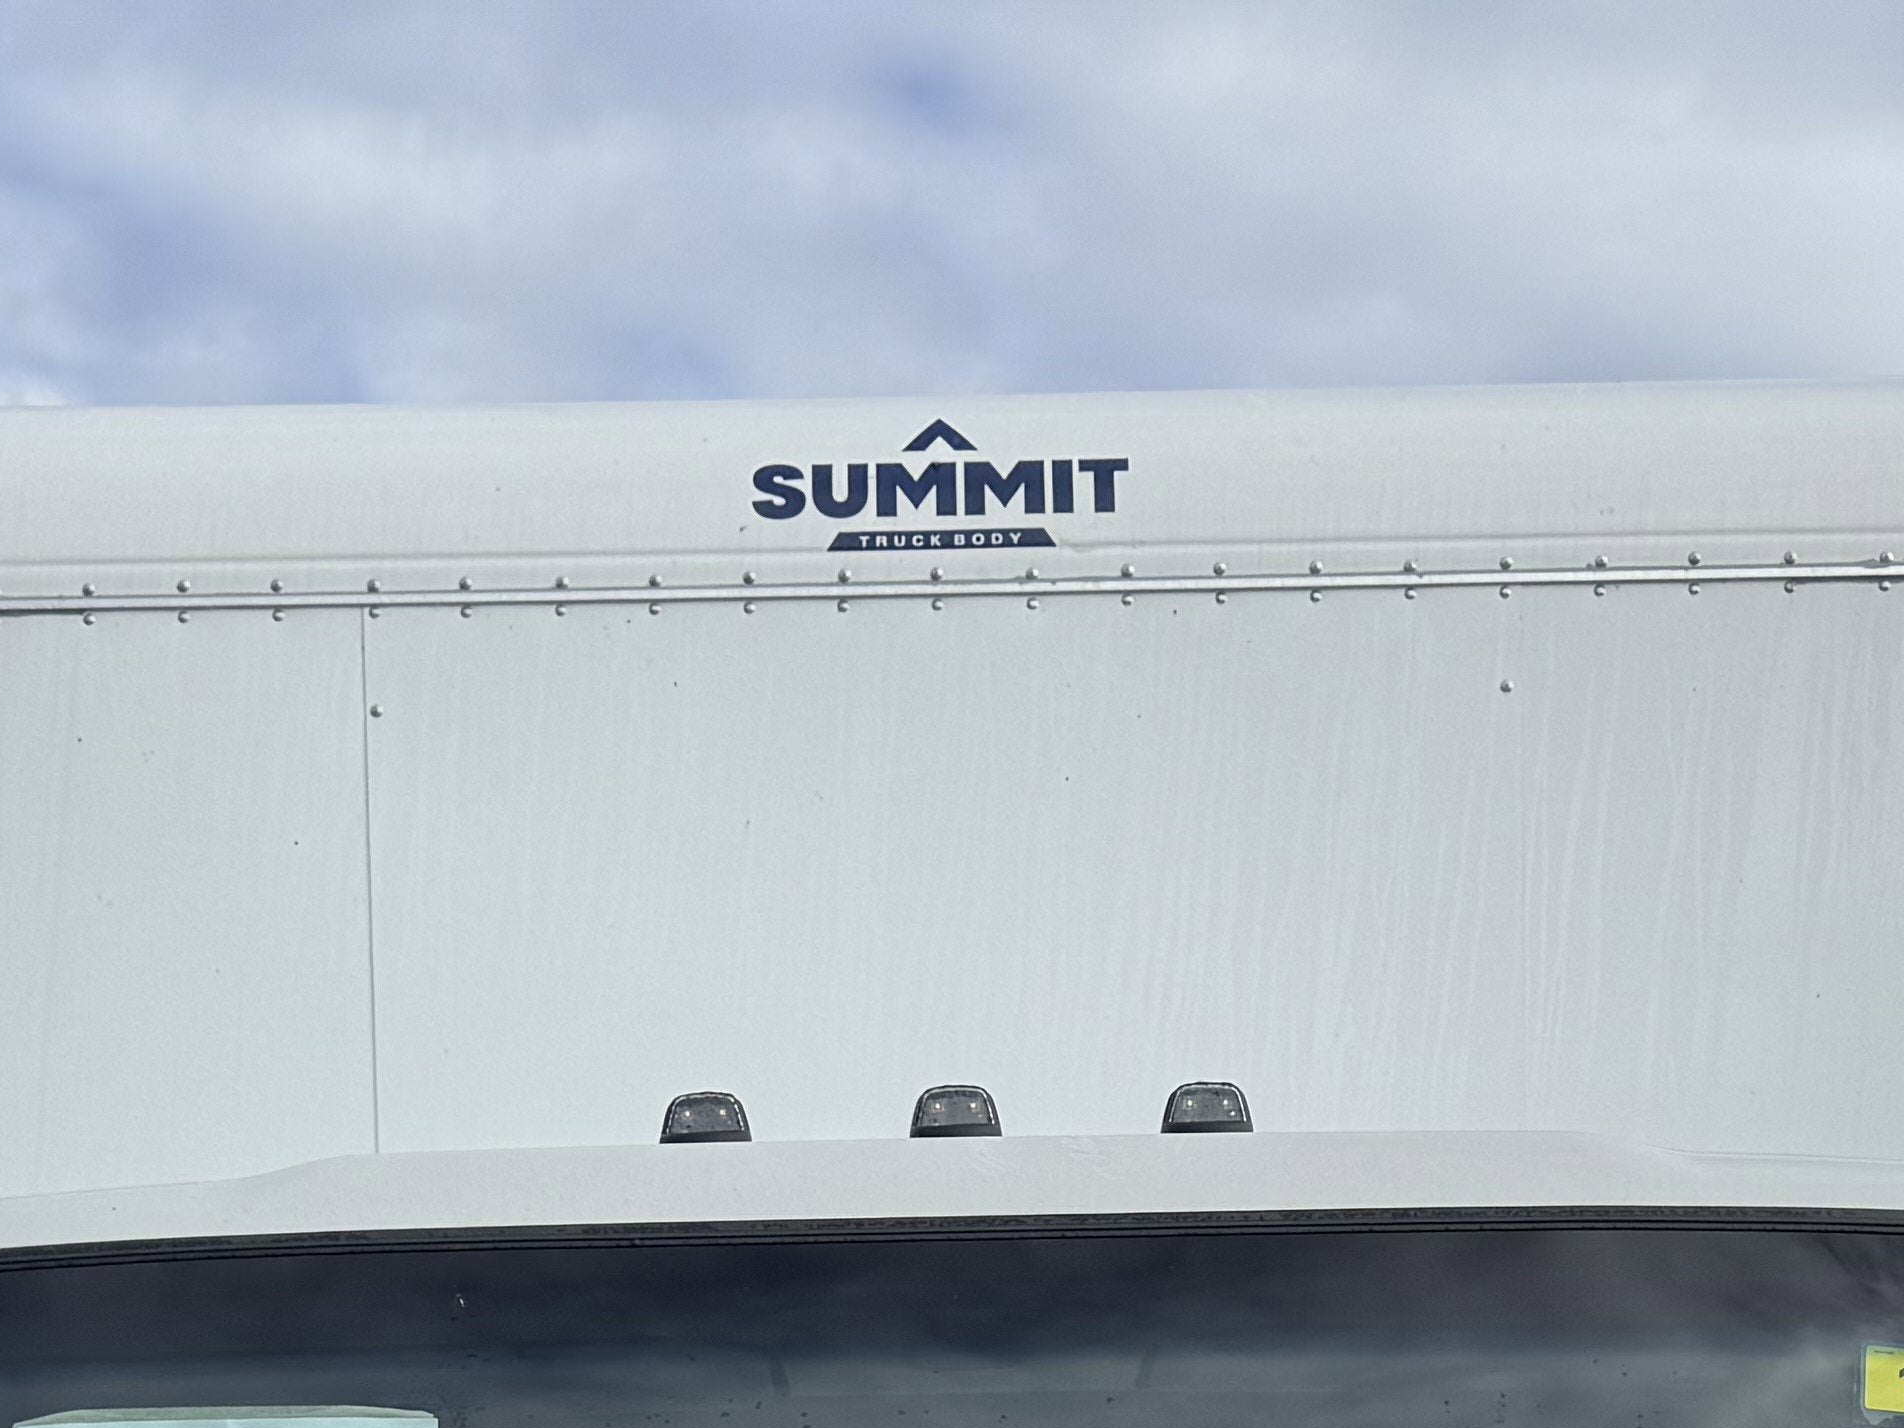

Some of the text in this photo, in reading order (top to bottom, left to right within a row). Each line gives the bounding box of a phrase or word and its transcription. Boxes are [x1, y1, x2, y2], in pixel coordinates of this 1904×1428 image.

[752, 457, 1129, 520] SUMMIT
[859, 532, 1022, 548] TRUCK BODY
